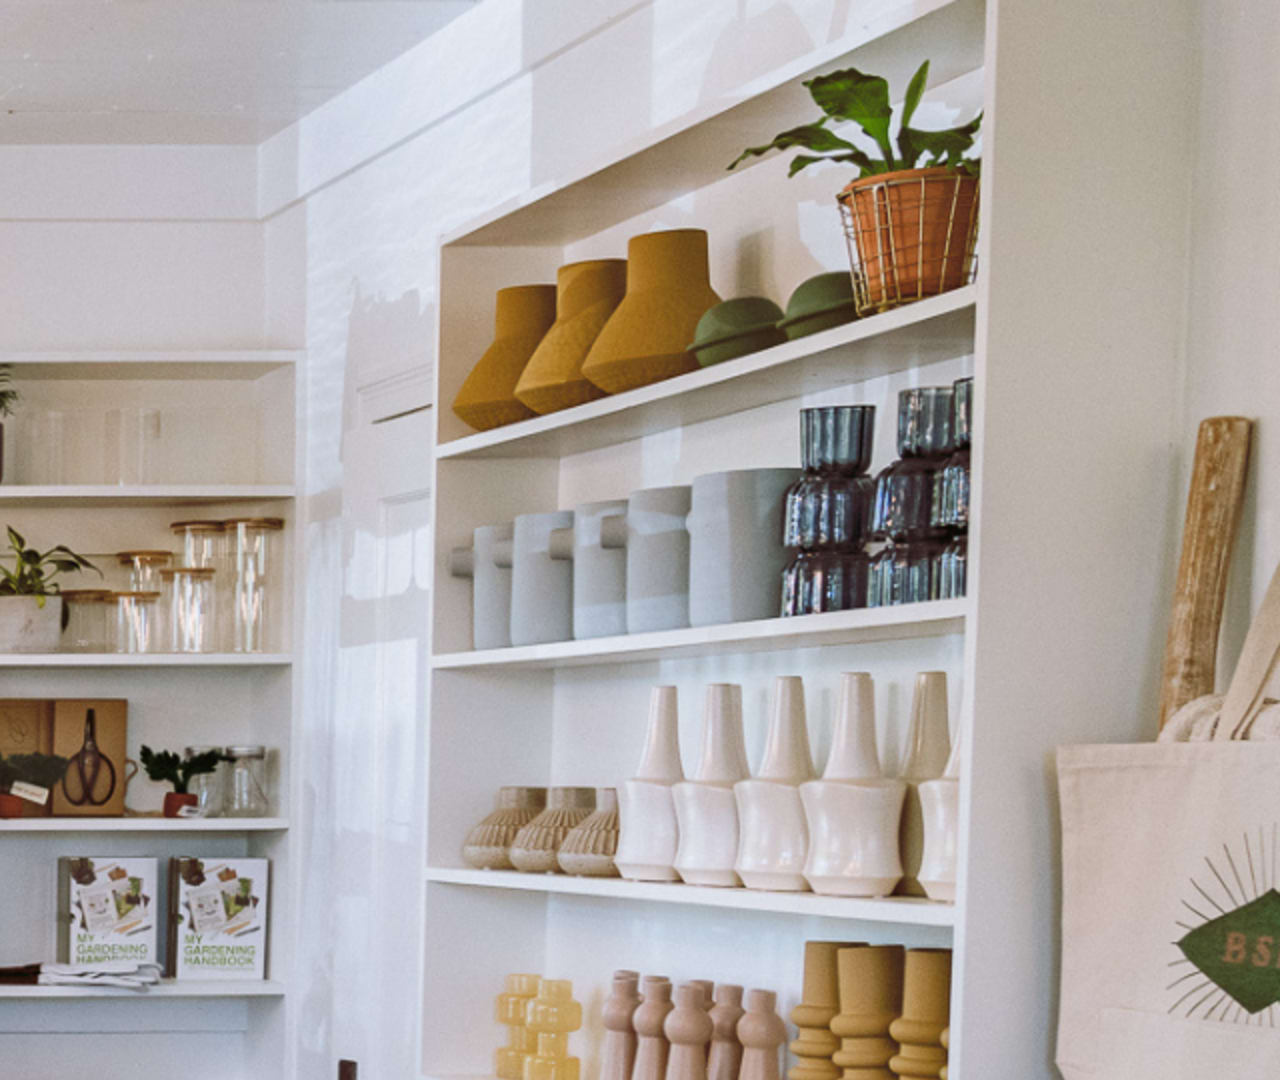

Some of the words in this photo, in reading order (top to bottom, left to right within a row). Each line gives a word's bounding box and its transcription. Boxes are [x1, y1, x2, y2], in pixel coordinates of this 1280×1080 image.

[76, 933, 95, 943] MY
[184, 935, 203, 945] MY
[76, 944, 149, 955] GARDENING
[183, 945, 256, 956] GARDENING
[1222, 931, 1280, 968] BS
[183, 956, 255, 967] HANDBOOK
